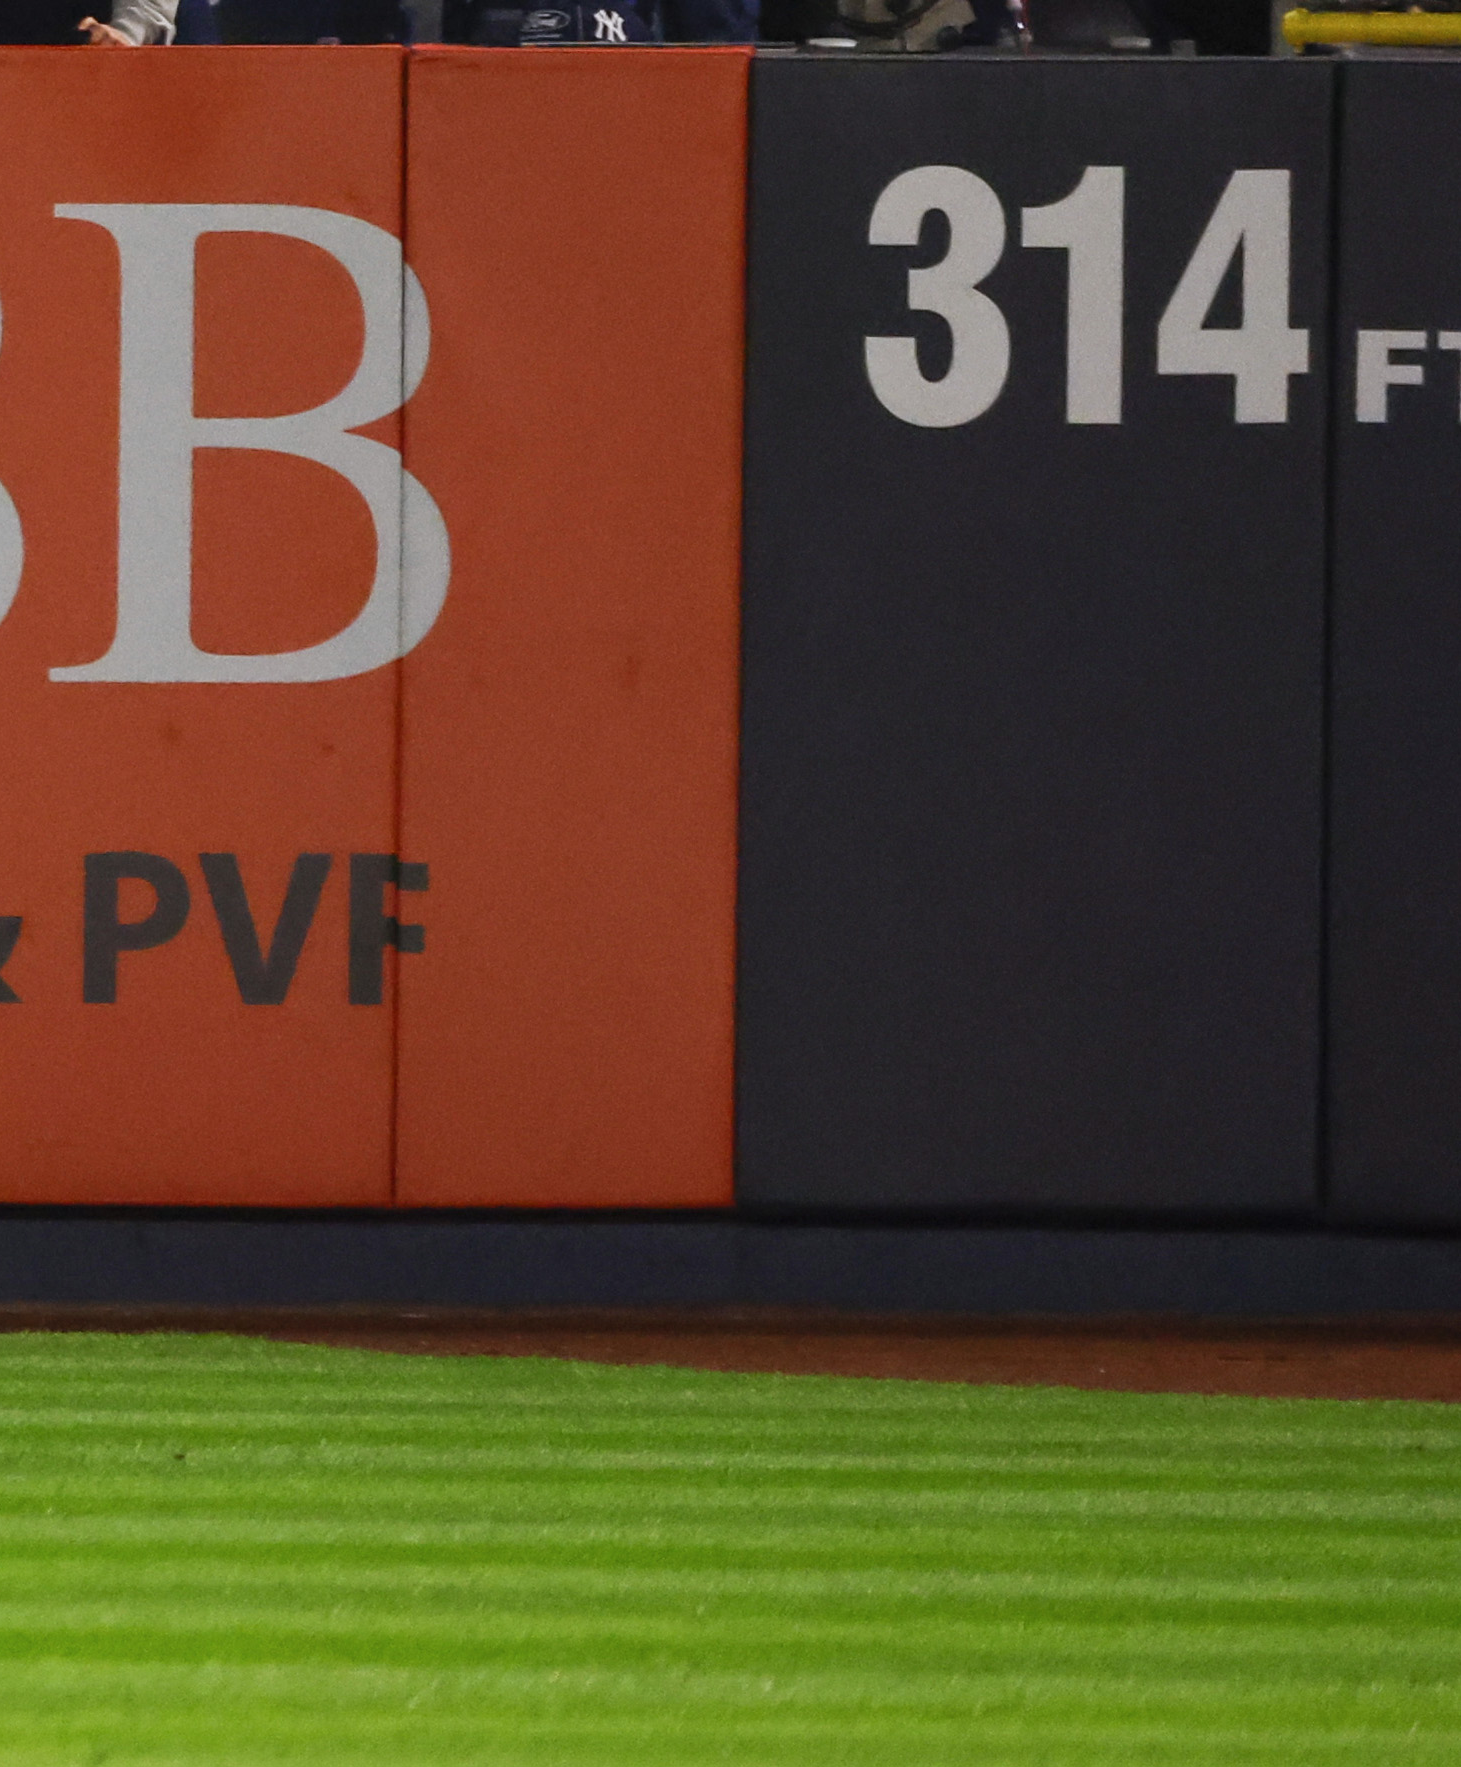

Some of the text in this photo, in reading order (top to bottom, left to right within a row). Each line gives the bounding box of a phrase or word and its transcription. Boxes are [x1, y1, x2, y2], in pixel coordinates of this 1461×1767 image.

[594, 8, 628, 43] NY
[863, 163, 1311, 429] 314
[79, 849, 430, 1008] PVF
